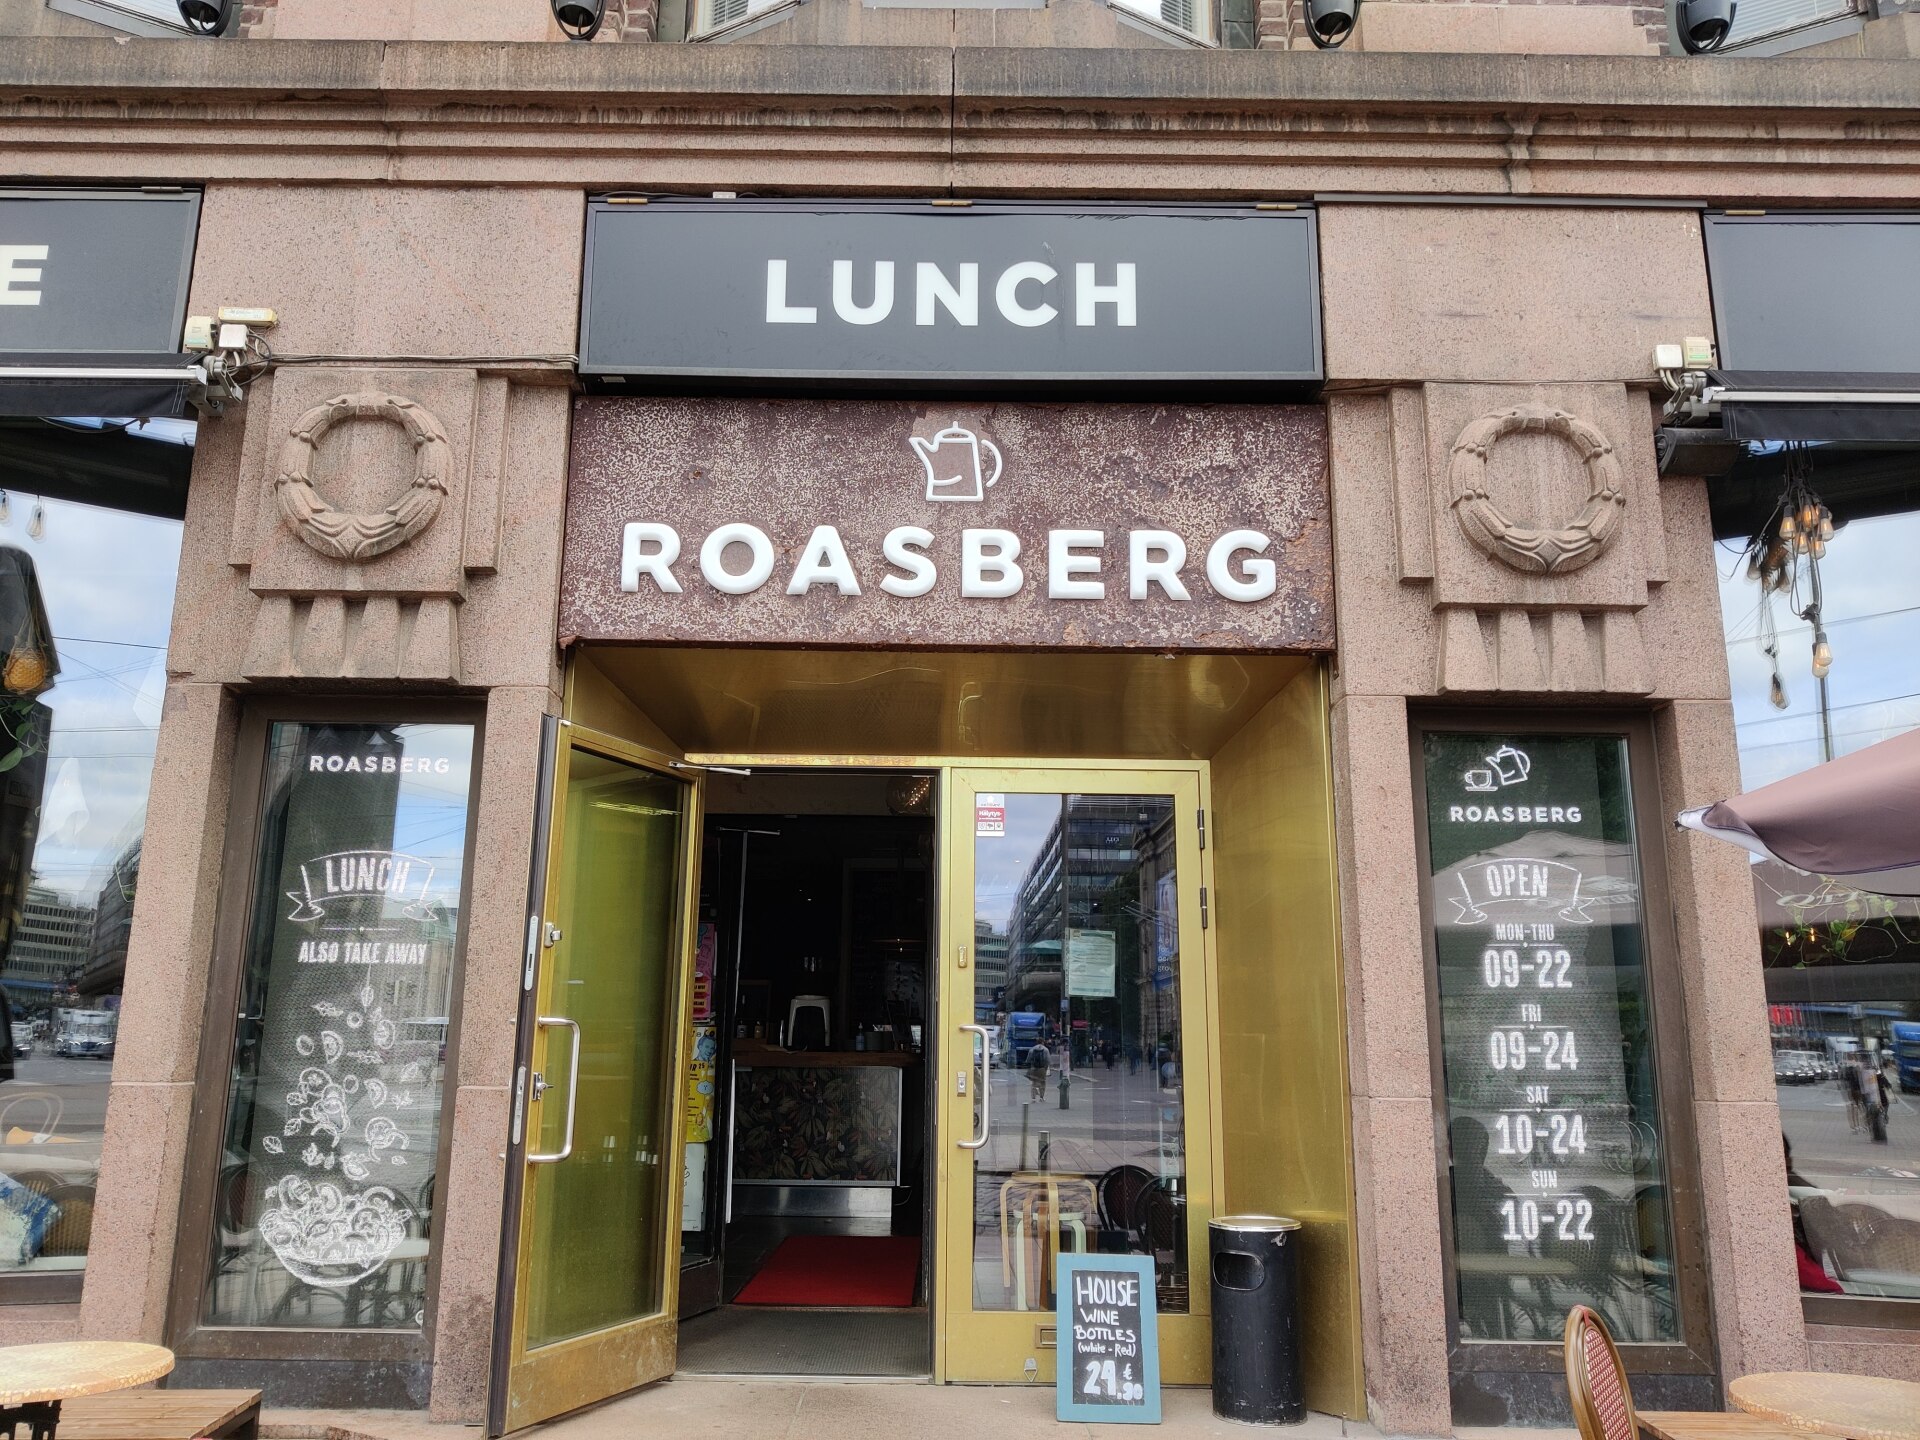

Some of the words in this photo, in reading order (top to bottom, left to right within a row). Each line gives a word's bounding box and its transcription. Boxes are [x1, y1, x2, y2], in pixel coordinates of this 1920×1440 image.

[766, 258, 1137, 328] LUNCH
[620, 521, 1278, 603] ROASBERG
[309, 754, 450, 774] ROASBERG
[1449, 805, 1583, 824] ROASBERG
[325, 857, 411, 894] LUNCH
[1486, 863, 1549, 898] OPEN
[1495, 923, 1556, 941] MON-THU
[297, 941, 339, 964] ALSO
[342, 941, 382, 965] TAKE
[384, 943, 428, 966] AWAY
[1483, 949, 1574, 989] 09-22
[1520, 1003, 1542, 1022] FRI
[1489, 1031, 1580, 1071] 09-24
[1525, 1085, 1550, 1104] SAT
[1495, 1114, 1588, 1155] 10-24
[1531, 1170, 1558, 1189] SUN
[1500, 1199, 1595, 1241] 10-22
[1075, 1275, 1139, 1307] HOUSE
[1080, 1307, 1120, 1326] WINE
[1073, 1324, 1136, 1343] BOTTLES
[1114, 1343, 1136, 1358] Red)
